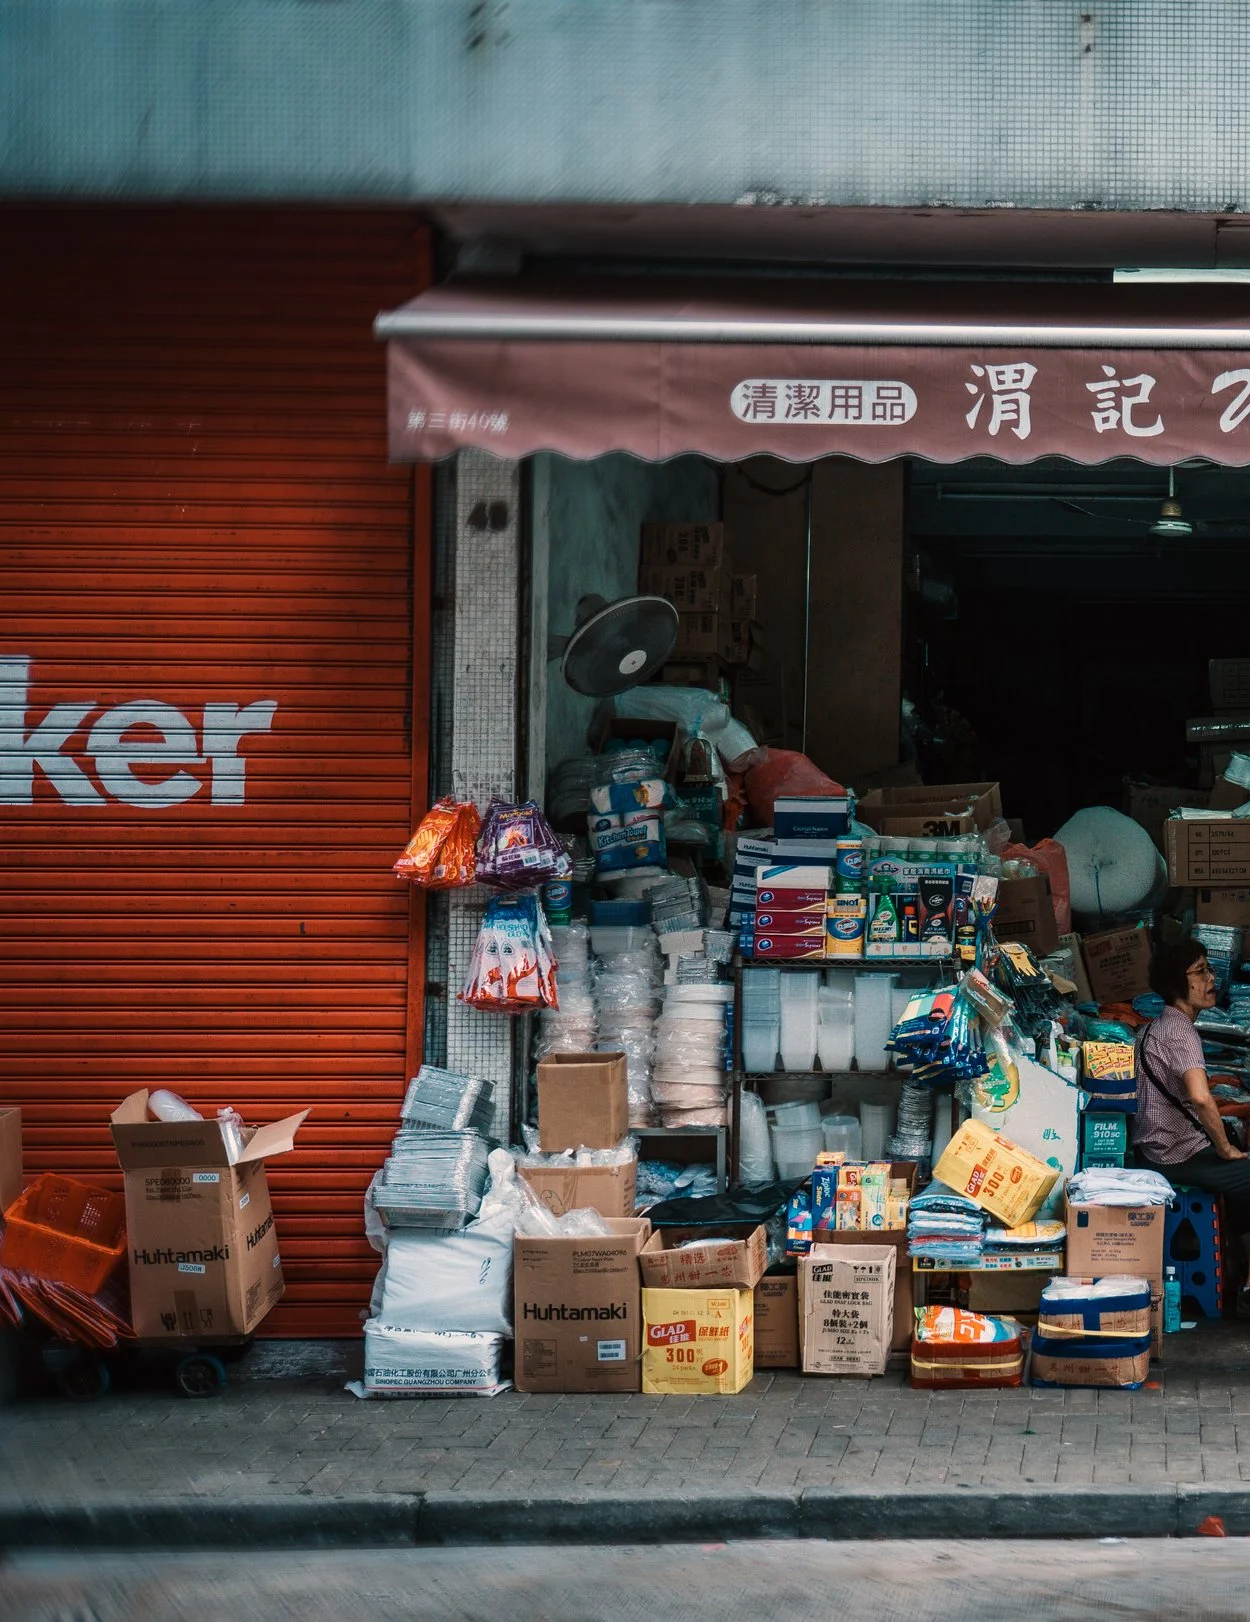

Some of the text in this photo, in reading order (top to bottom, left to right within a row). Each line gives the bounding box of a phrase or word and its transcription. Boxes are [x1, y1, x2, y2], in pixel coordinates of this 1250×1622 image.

[740, 383, 908, 422] 清潔用品
[0, 654, 278, 808] ker
[1094, 1123, 1118, 1131] FILM
[982, 1171, 1005, 1197] 300
[134, 1244, 230, 1265] Huhtamaki
[813, 1264, 833, 1274] GLAD
[823, 1290, 870, 1300] 佳能密實袋
[523, 1302, 628, 1321] Huhtamaki
[832, 1309, 860, 1319] 特大袋
[650, 1324, 686, 1339] GLAD
[698, 1326, 730, 1338] 保鮮紙
[666, 1348, 695, 1363] 300
[445, 1378, 477, 1386] COMPANY
